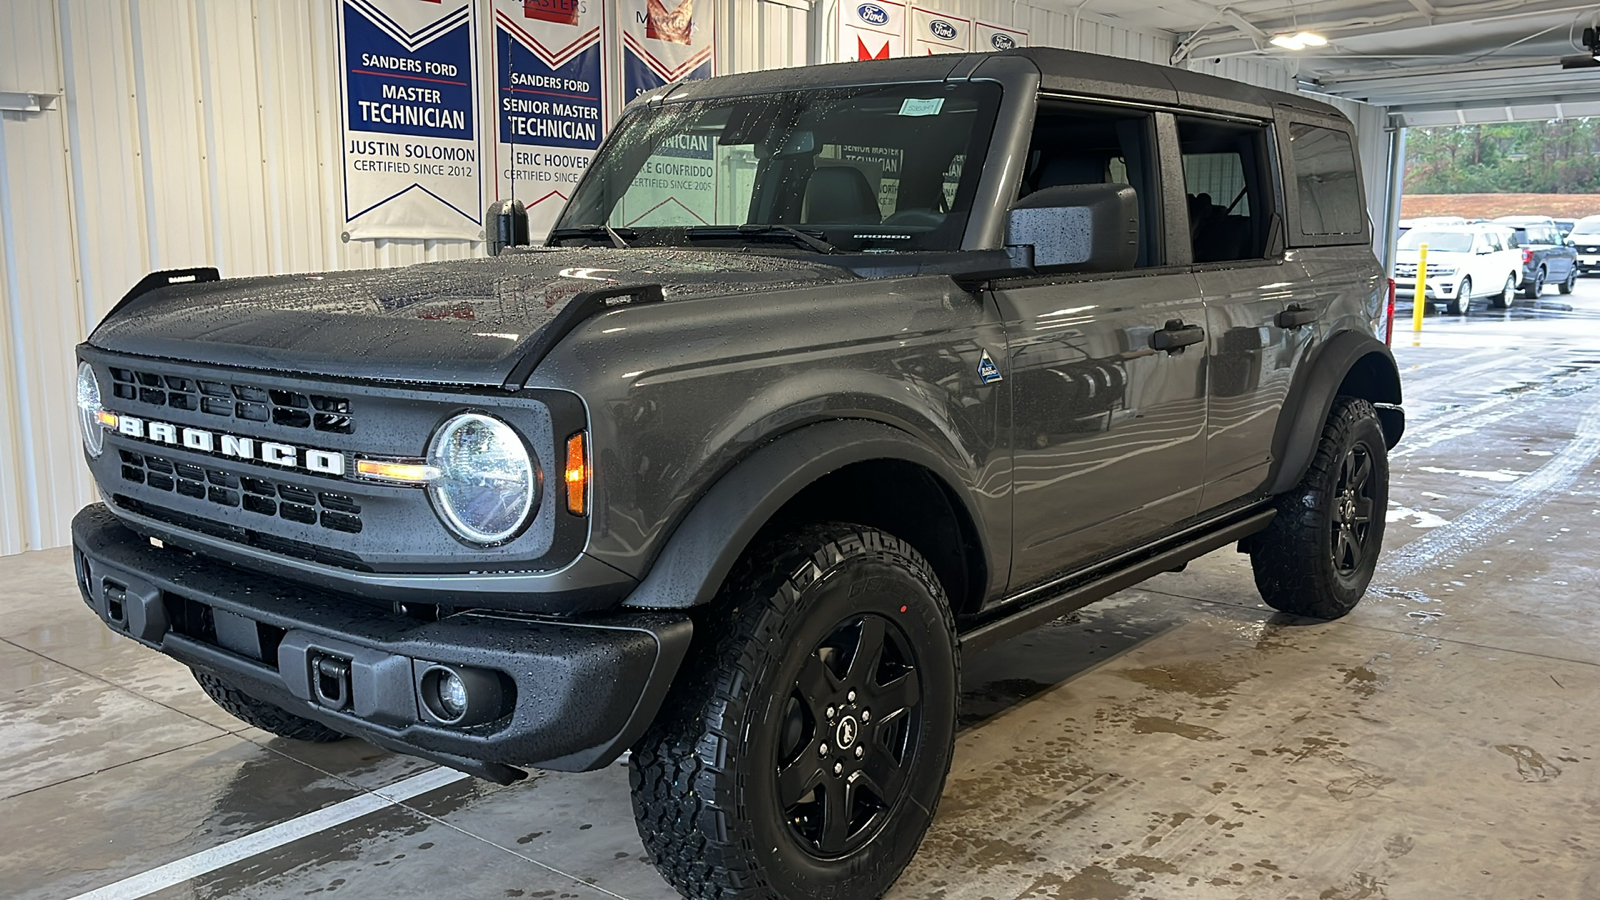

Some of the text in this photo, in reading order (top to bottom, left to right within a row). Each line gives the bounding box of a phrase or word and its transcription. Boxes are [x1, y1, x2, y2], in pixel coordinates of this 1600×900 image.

[862, 5, 885, 24] Ford
[933, 21, 954, 39] Ford
[995, 34, 1013, 50] Ford
[362, 53, 458, 77] SANDERS FORD
[511, 72, 590, 93] SANDERS FORD
[382, 84, 441, 104] MASTER
[358, 100, 465, 130] TECHNICIAN
[503, 97, 598, 120] SENIOR MASTER
[508, 115, 596, 141] TECHNICIAN
[349, 140, 475, 162] JUSTIN SOLOMON
[516, 152, 590, 169] ERIC HOOVER
[353, 160, 472, 177] CERTIFIED SINCE 2012
[503, 169, 578, 183] CERTIFIED SINCE
[655, 163, 713, 178] GIONFRIDDO
[631, 178, 669, 189] ERTIFIED
[670, 180, 692, 190] SINCE
[118, 415, 345, 476] BRONCO
